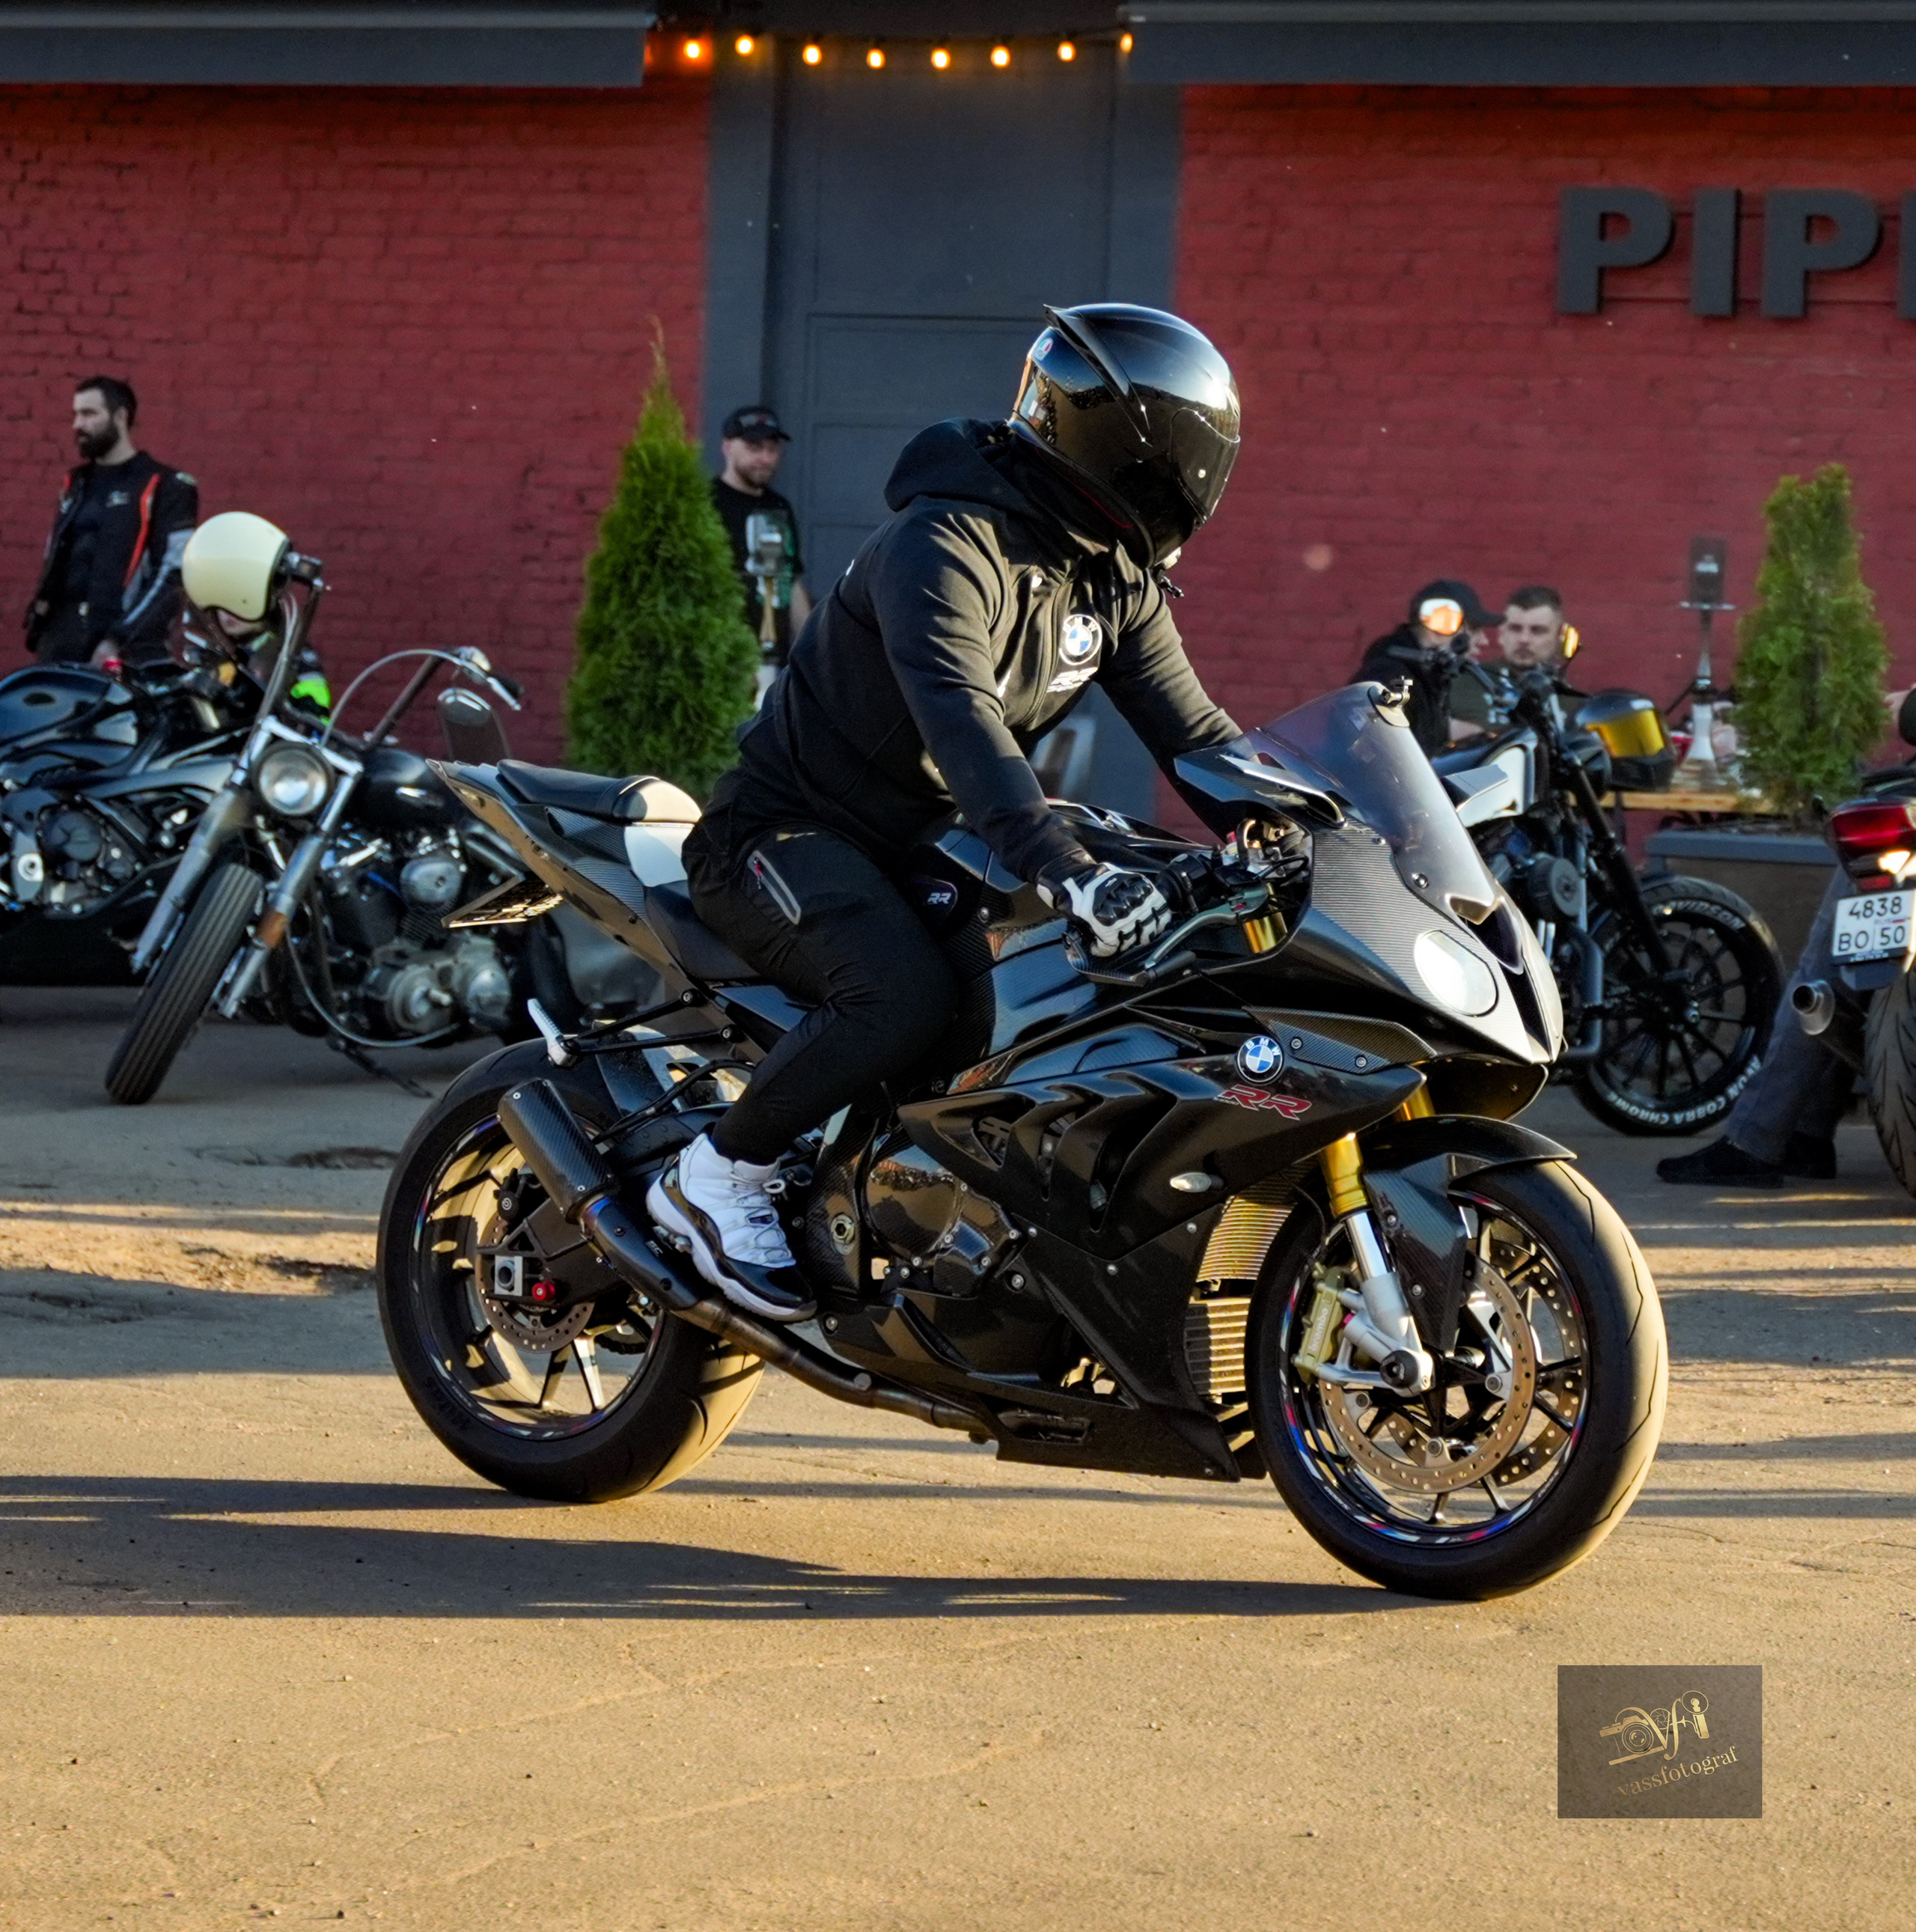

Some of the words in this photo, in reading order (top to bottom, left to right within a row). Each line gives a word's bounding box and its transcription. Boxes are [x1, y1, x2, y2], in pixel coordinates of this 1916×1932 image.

[1557, 186, 1916, 320] PIP
[1063, 616, 1098, 633] BMW
[927, 892, 951, 904] RR
[1849, 896, 1902, 920] 4838
[1879, 925, 1905, 945] 50
[1245, 1037, 1281, 1056] BMW
[1218, 1084, 1312, 1121] RR
[1606, 1091, 1671, 1125] CHROME
[1672, 1094, 1727, 1125] COBRA
[1308, 1308, 1328, 1351] brembo
